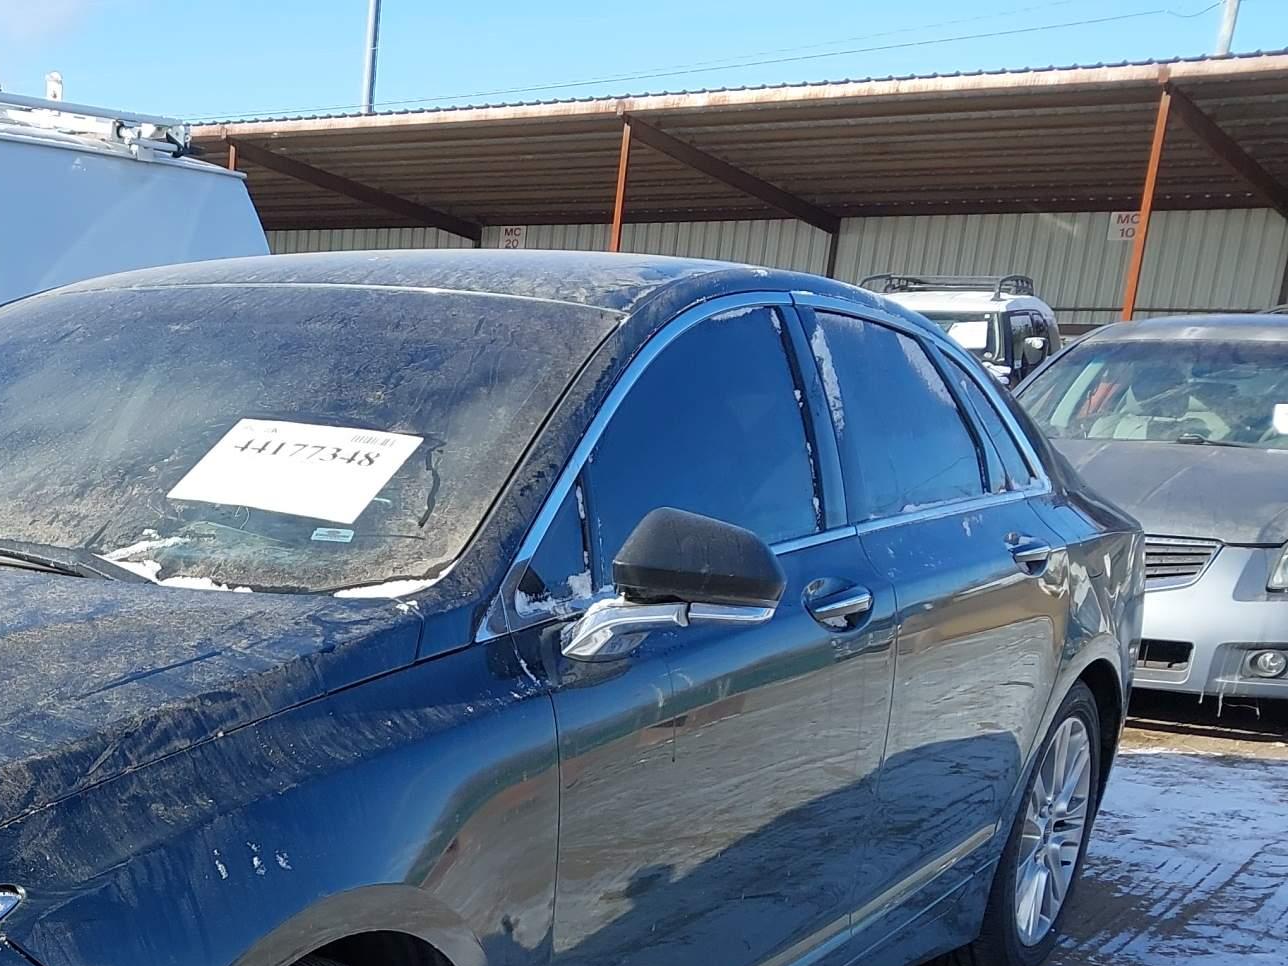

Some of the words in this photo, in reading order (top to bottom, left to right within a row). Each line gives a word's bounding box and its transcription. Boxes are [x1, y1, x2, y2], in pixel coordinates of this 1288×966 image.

[1116, 213, 1141, 225] MC
[504, 227, 522, 237] MC
[1119, 227, 1136, 238] 10
[504, 238, 519, 248] 20
[234, 438, 381, 467] 44177348
